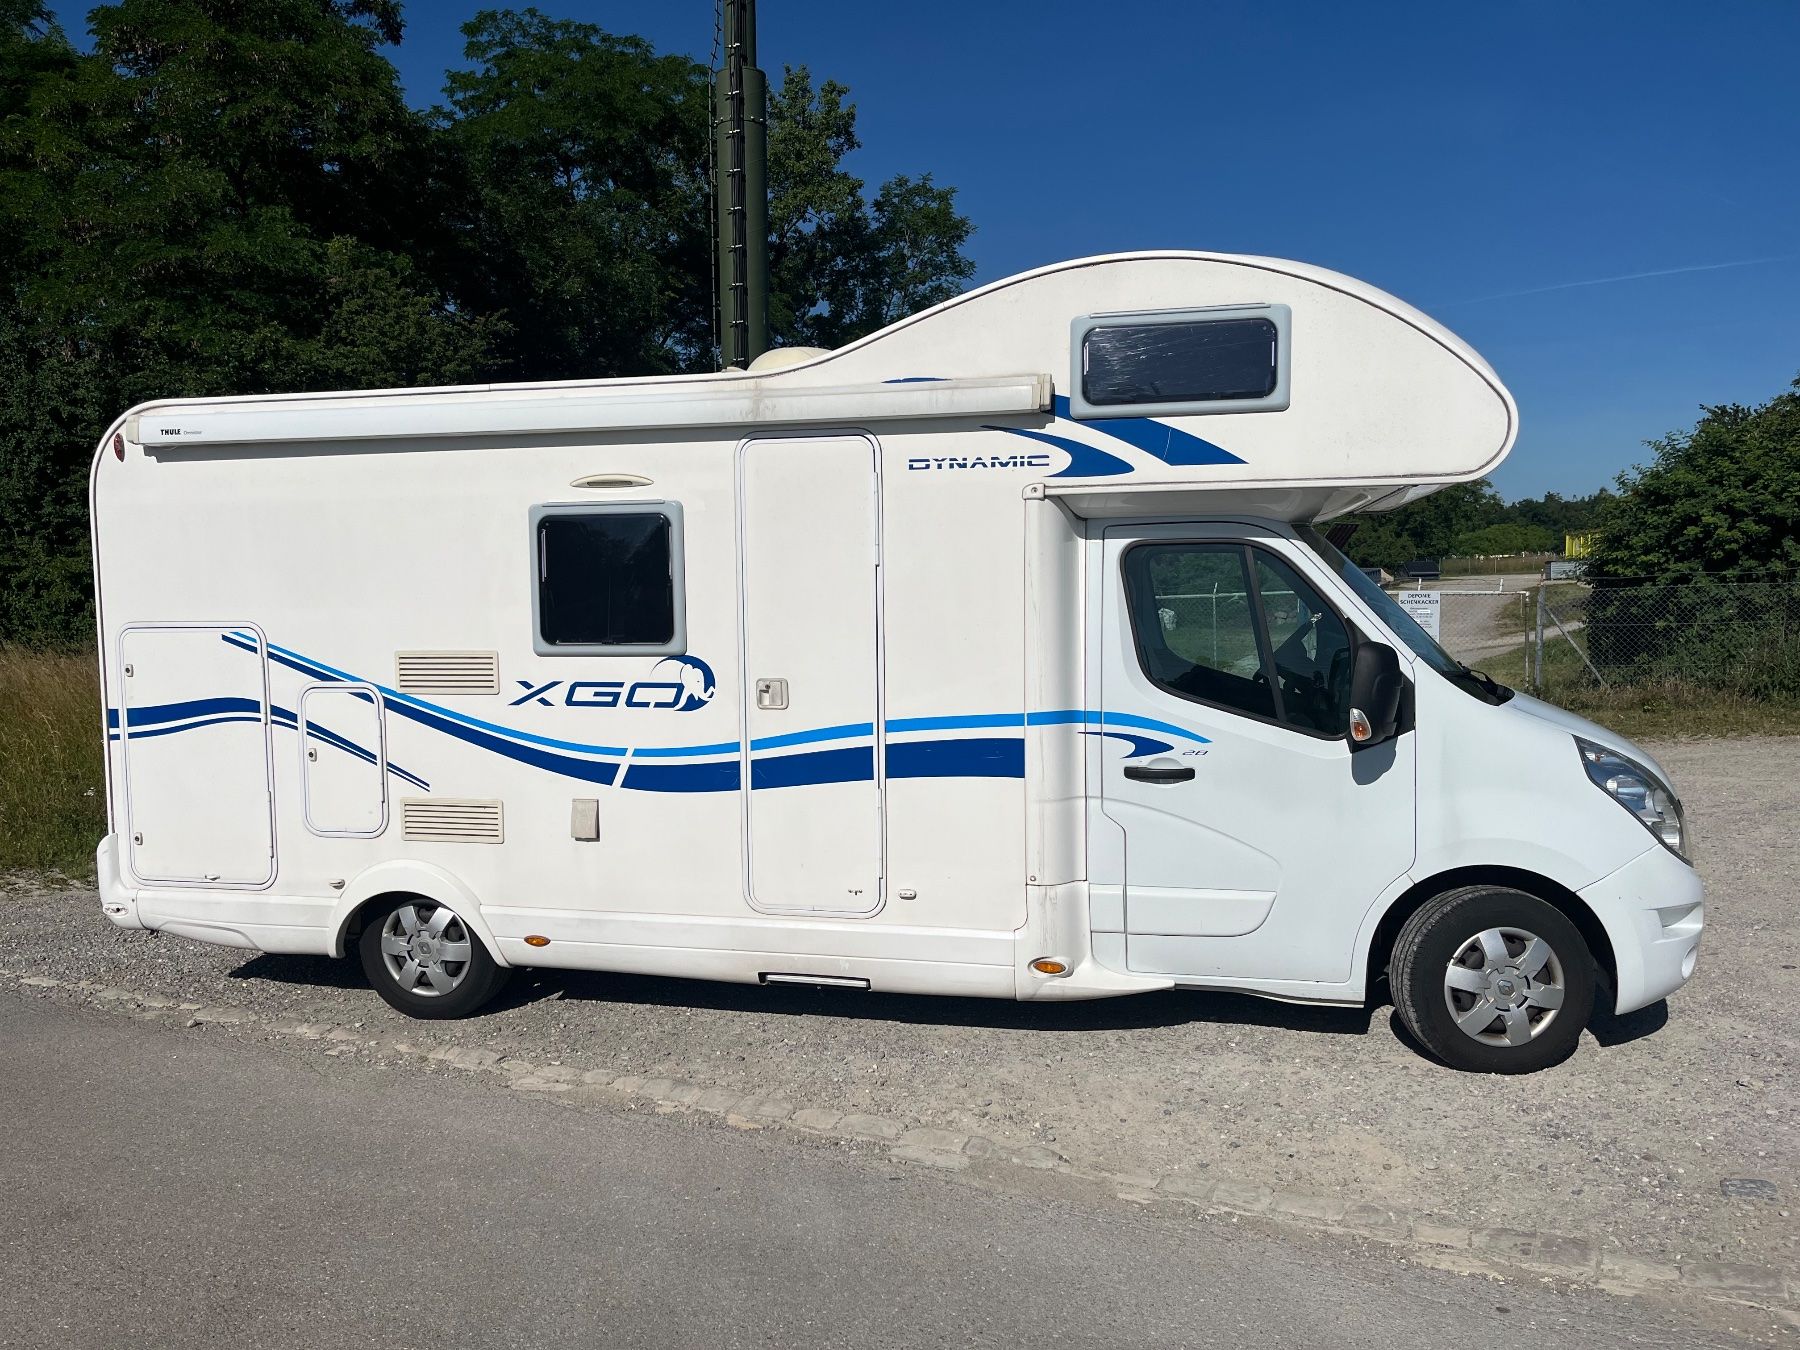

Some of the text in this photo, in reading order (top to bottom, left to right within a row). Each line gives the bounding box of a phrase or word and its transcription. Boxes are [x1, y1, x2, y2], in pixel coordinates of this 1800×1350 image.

[160, 428, 181, 436] THULE
[908, 454, 1050, 470] DYNAMIC
[508, 680, 686, 709] XGO
